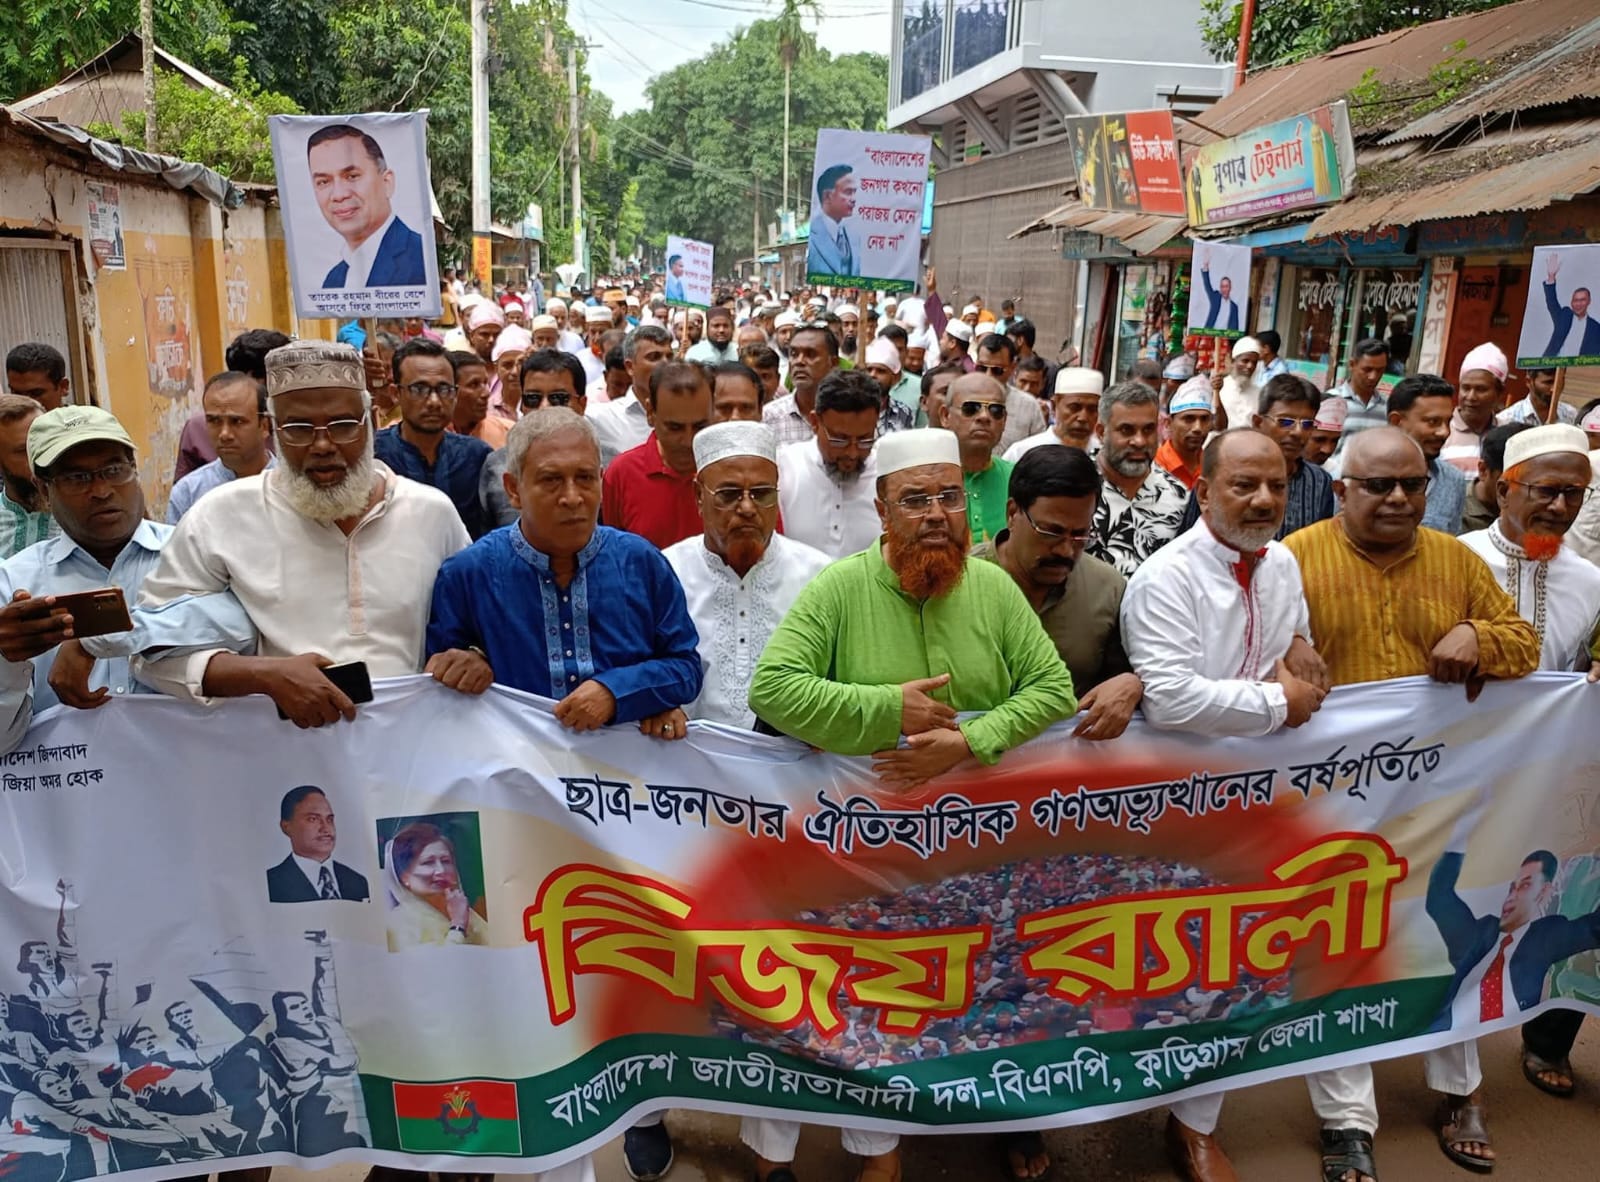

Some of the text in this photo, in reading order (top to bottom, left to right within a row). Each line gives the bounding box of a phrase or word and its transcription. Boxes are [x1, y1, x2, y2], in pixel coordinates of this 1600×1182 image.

[861, 178, 923, 197] জনগণ কখনো
[1212, 155, 1246, 193] সুপার
[858, 206, 917, 224] পরাজয় মেনে
[868, 235, 886, 250] নেয়
[1, 773, 36, 792] জিয়া
[67, 769, 104, 787] হোক
[558, 773, 790, 840] ছাত্র-জনতার
[805, 790, 1020, 859] ঐতিহাসিক
[1288, 736, 1446, 801] বর্ষপূর্তিতে
[525, 863, 991, 1036] বিজয়
[546, 997, 1399, 1127] বাংলাদেশ জাতীয়তাবাদী দল-বিএনপি, কুড়িগ্রাম জেলা শাখা
